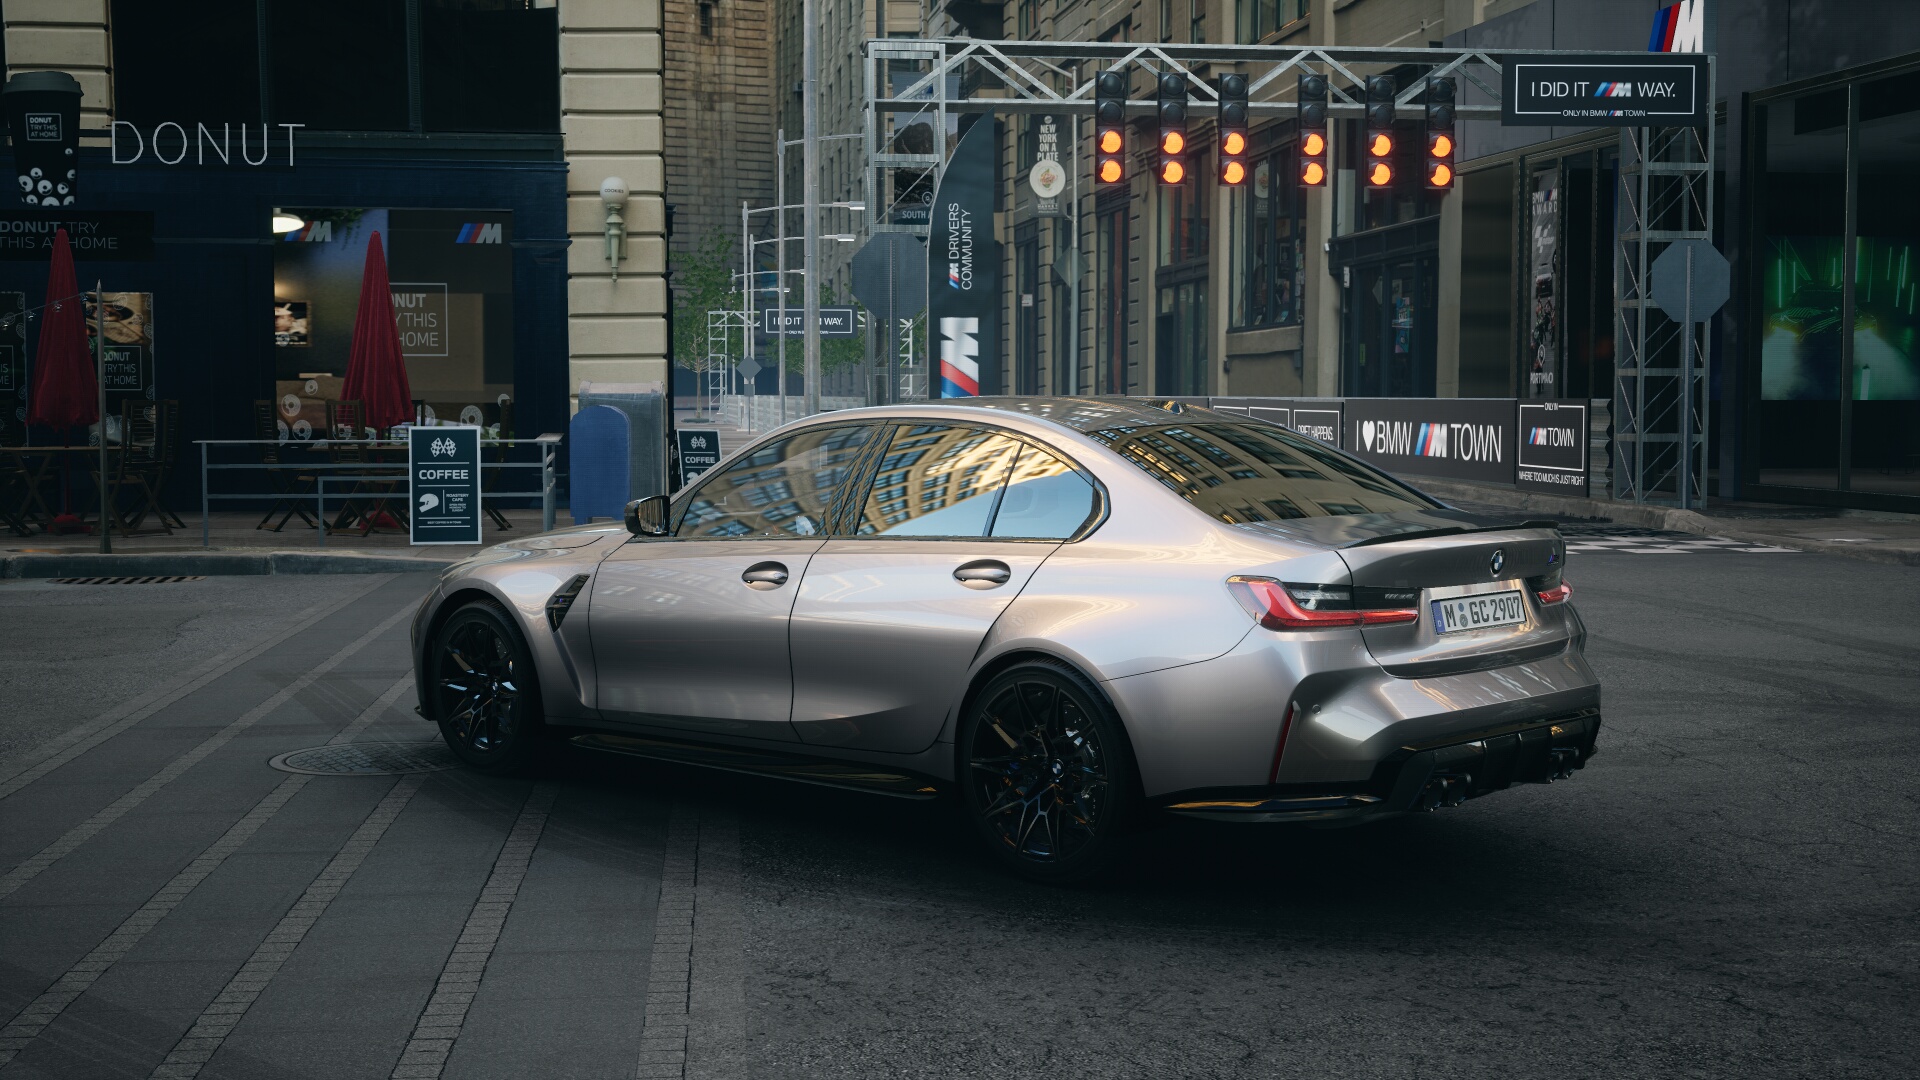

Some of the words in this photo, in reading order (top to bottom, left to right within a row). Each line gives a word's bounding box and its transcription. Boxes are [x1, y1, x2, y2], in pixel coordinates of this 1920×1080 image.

[1531, 81, 1535, 97] I
[1539, 81, 1570, 97] DID
[1574, 81, 1590, 97] IT
[1594, 81, 1632, 97] M
[1637, 82, 1676, 98] WAY.
[1562, 109, 1581, 118] ONLY
[1581, 109, 1589, 118] IN
[1589, 109, 1608, 118] BMW
[1624, 109, 1646, 117] TOWN
[1040, 124, 1057, 134] NEW
[111, 120, 306, 167] DONUT
[1038, 133, 1057, 143] YORK
[1039, 143, 1049, 152] ON
[1050, 143, 1057, 152] A
[1037, 152, 1059, 161] PLATE
[902, 210, 926, 219] SOUTH
[0, 221, 62, 233] DONUT
[65, 222, 100, 234] TRY
[948, 202, 960, 260] DRIVERS
[0, 236, 36, 249] THIS
[961, 208, 973, 290] COMMUNITY
[403, 312, 437, 328] THIS
[824, 317, 844, 326] WAY.
[118, 363, 137, 373] THIS
[113, 375, 138, 385] HOME
[1544, 402, 1554, 411] ONLY
[1553, 402, 1559, 411] IN
[1377, 420, 1412, 456] BMW
[1414, 422, 1448, 458] M
[1450, 423, 1502, 463] TOWN
[1528, 426, 1547, 446] M
[1547, 427, 1575, 447] TOWN
[685, 456, 716, 464] COFFEE
[418, 469, 469, 480] COFFEE
[1518, 470, 1533, 481] WHERE
[1533, 471, 1543, 482] TOO
[1542, 472, 1554, 483] MUCH
[1554, 473, 1560, 484] IS
[1559, 474, 1571, 485] JUST
[1570, 475, 1585, 486] RIGHT
[1443, 603, 1457, 628] M
[1469, 600, 1490, 625] GC
[1490, 596, 1521, 622] 2907
